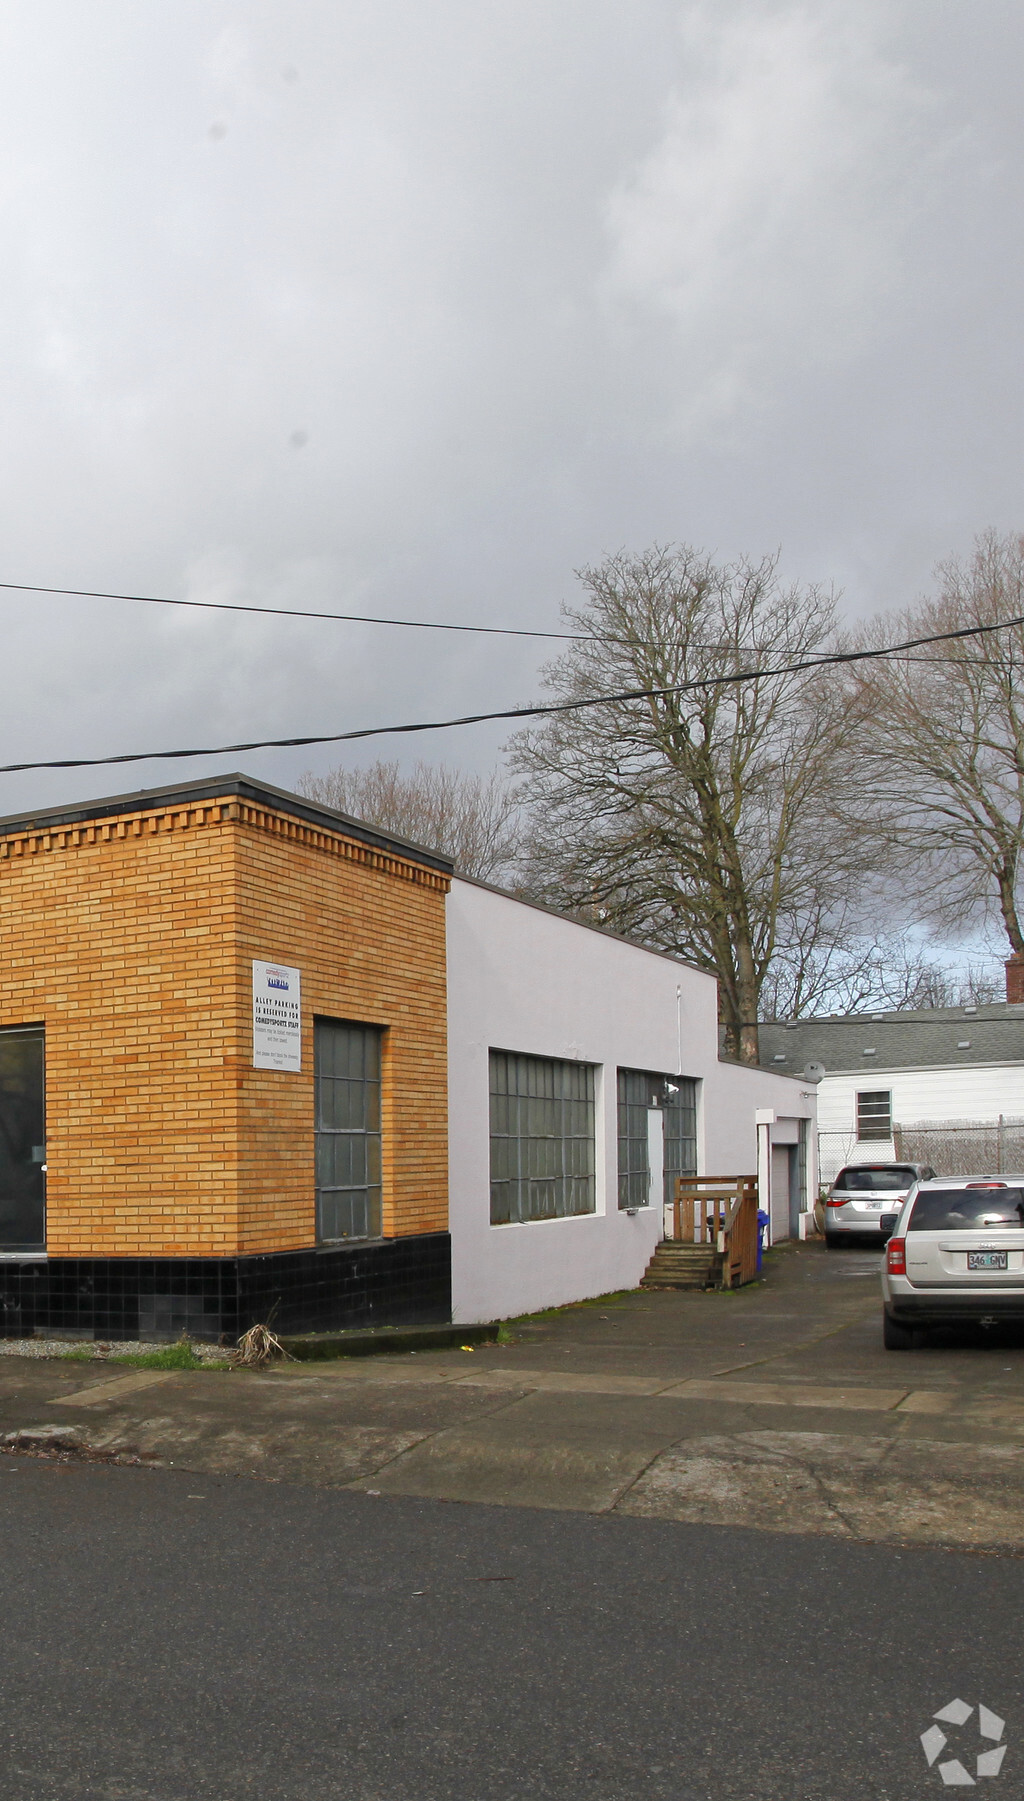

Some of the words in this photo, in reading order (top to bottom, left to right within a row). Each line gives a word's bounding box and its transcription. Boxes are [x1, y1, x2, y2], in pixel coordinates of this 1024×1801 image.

[255, 997, 272, 1006] ALLEY
[274, 1000, 299, 1010] PARKING
[263, 1008, 288, 1018] RESERVED
[255, 1017, 287, 1027] COMEDYSPORTZ
[288, 1021, 299, 1029] STAFF
[969, 1255, 985, 1266] 346
[990, 1255, 1006, 1265] GNV
